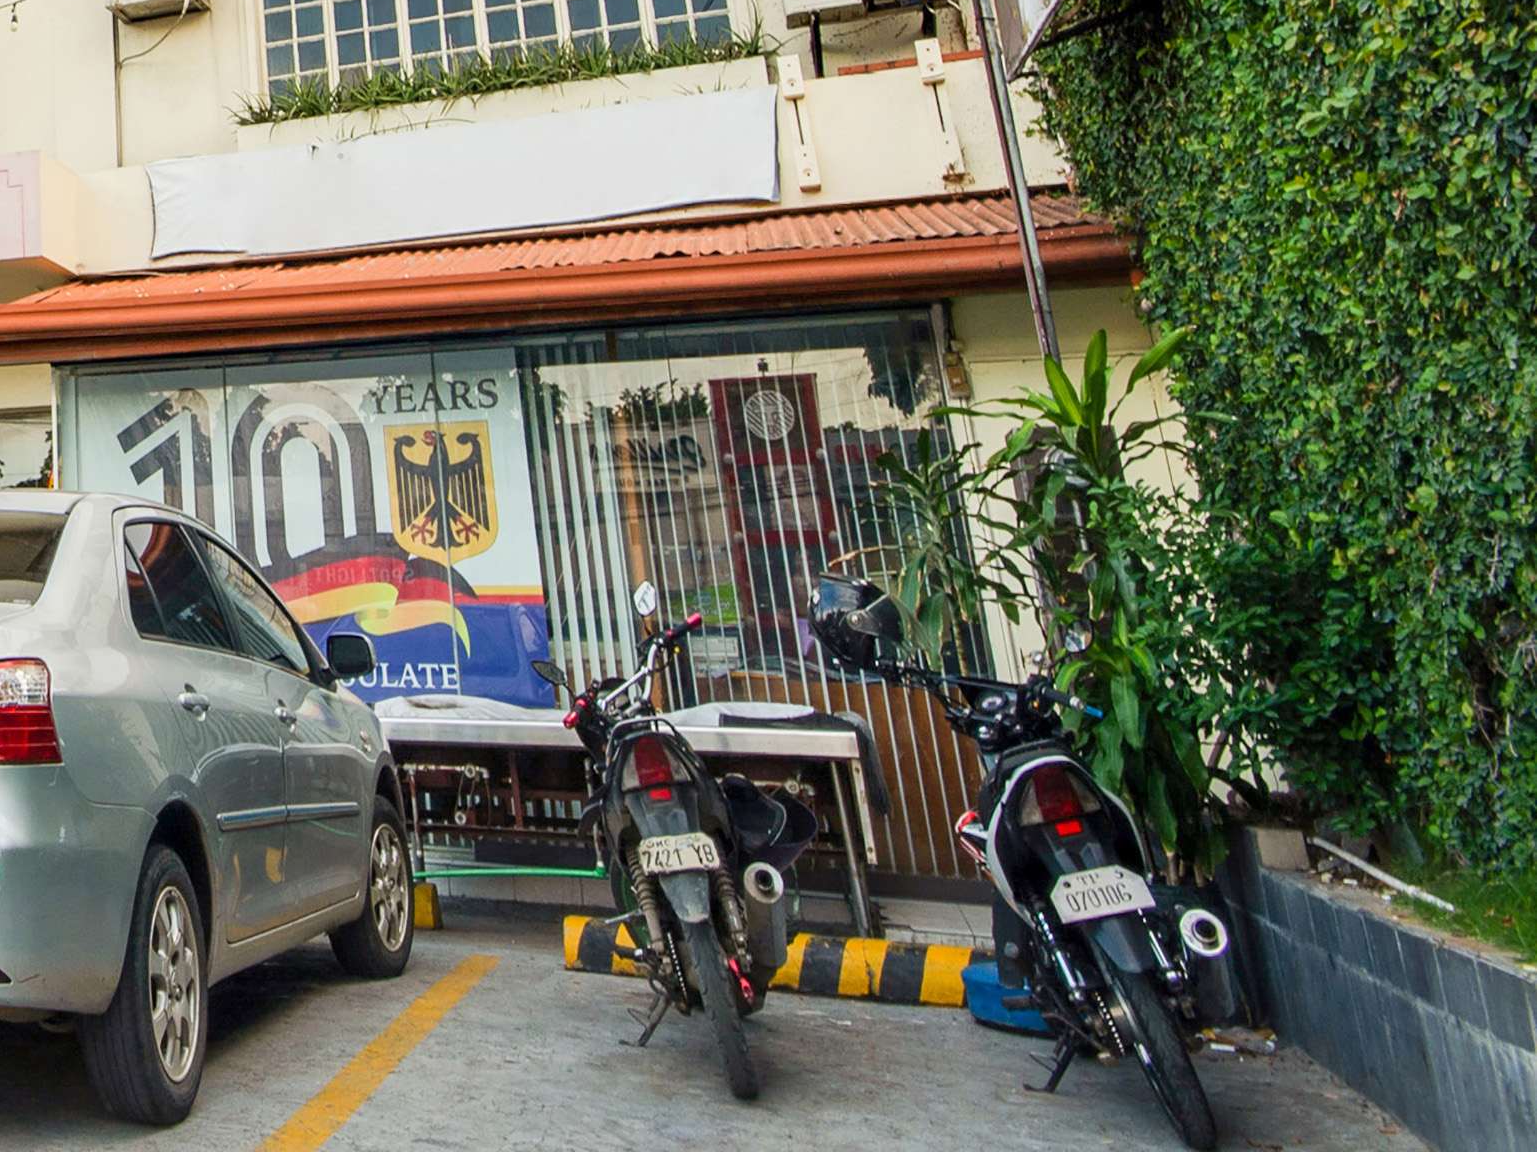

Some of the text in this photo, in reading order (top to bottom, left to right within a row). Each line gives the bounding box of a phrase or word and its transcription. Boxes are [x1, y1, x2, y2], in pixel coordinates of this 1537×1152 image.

[368, 377, 499, 415] YEARS
[339, 663, 460, 690] ULATE
[642, 847, 683, 869] 7421
[1065, 883, 1133, 913] 070106
